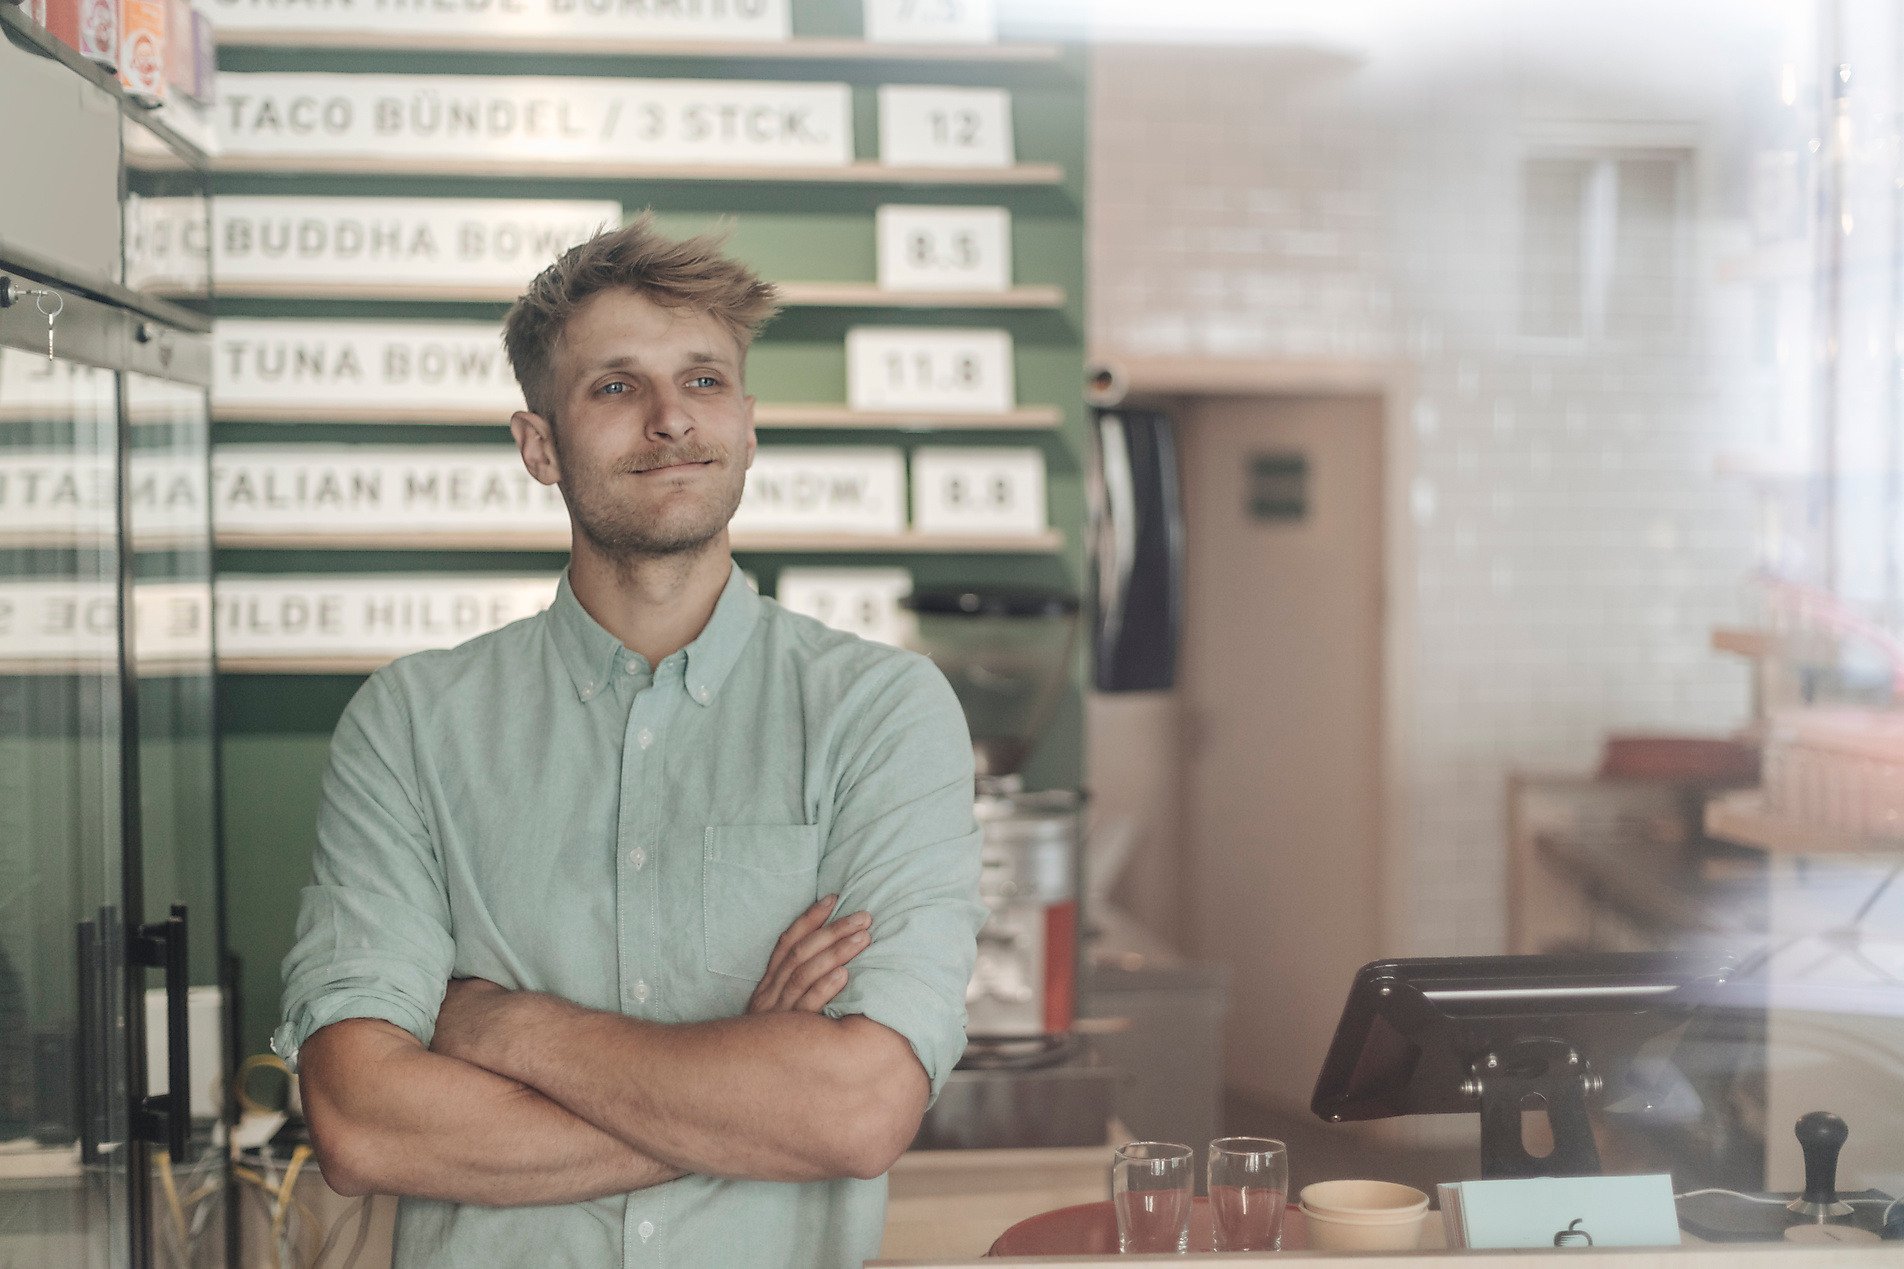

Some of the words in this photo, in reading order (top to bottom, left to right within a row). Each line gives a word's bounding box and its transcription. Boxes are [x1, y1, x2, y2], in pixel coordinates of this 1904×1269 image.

[227, 97, 354, 135] TACO
[373, 89, 587, 138] BÜNDEL
[641, 103, 668, 141] 3
[680, 103, 831, 145] STCK.
[928, 109, 983, 148] 12
[222, 217, 441, 260] BUDDHA
[226, 341, 365, 385] TUNA
[213, 594, 344, 637] ILDE
